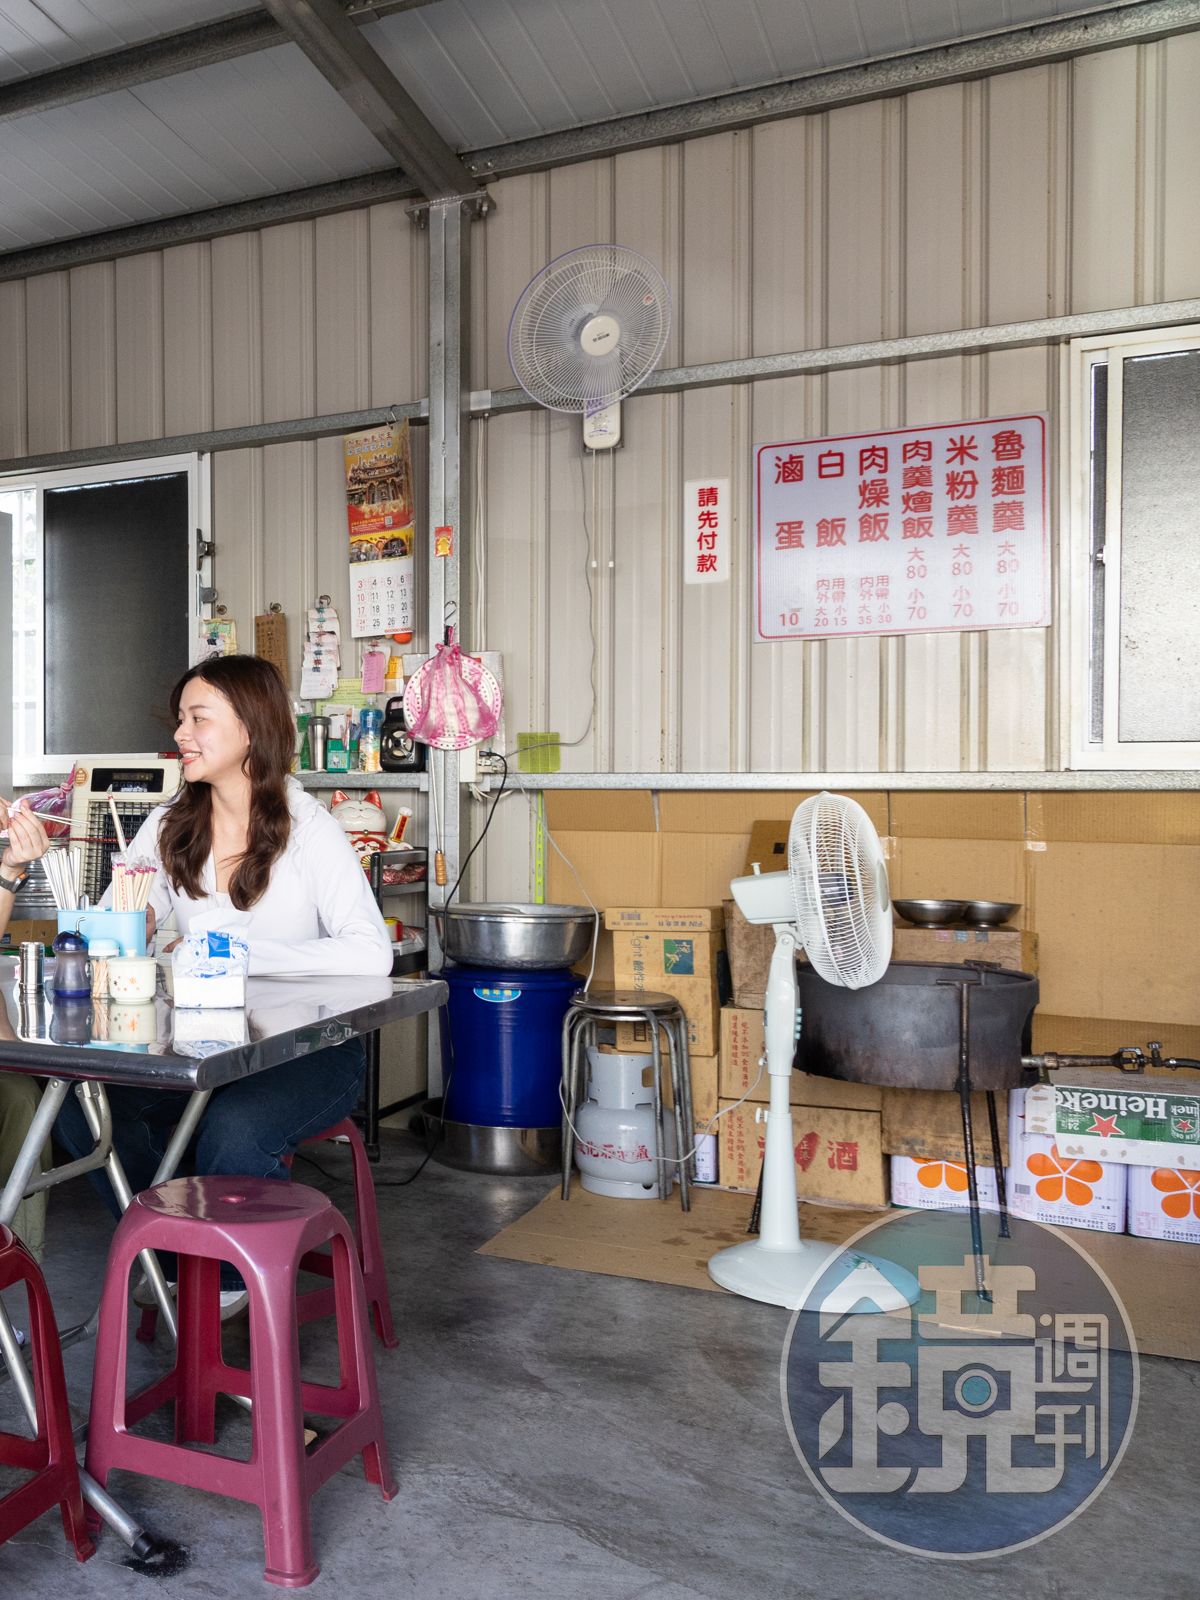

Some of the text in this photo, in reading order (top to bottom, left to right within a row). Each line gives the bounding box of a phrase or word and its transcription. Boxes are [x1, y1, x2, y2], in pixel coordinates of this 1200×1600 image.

[945, 434, 979, 537] 米粉羹
[991, 429, 1025, 533] 魯麵羹
[858, 445, 890, 543] 肉燥飯
[901, 439, 934, 540] 肉羹燴飯
[815, 450, 847, 548] 白飯
[696, 486, 719, 573] 請先付款
[906, 565, 928, 579] 80
[951, 562, 973, 576] 80
[996, 559, 1020, 574] 80
[357, 593, 365, 602] 10
[372, 592, 379, 600] 11
[386, 590, 394, 598] 12
[357, 602, 408, 615] 17 18 19 20
[907, 606, 928, 621] 70
[952, 604, 973, 618] 70
[998, 601, 1020, 617] 70
[372, 618, 381, 627] 25
[387, 617, 395, 626] 26
[402, 615, 409, 624] 27
[778, 612, 799, 627] 10
[813, 616, 847, 627] 20 15
[858, 614, 892, 625] 35 30
[827, 1139, 860, 1172] 酒
